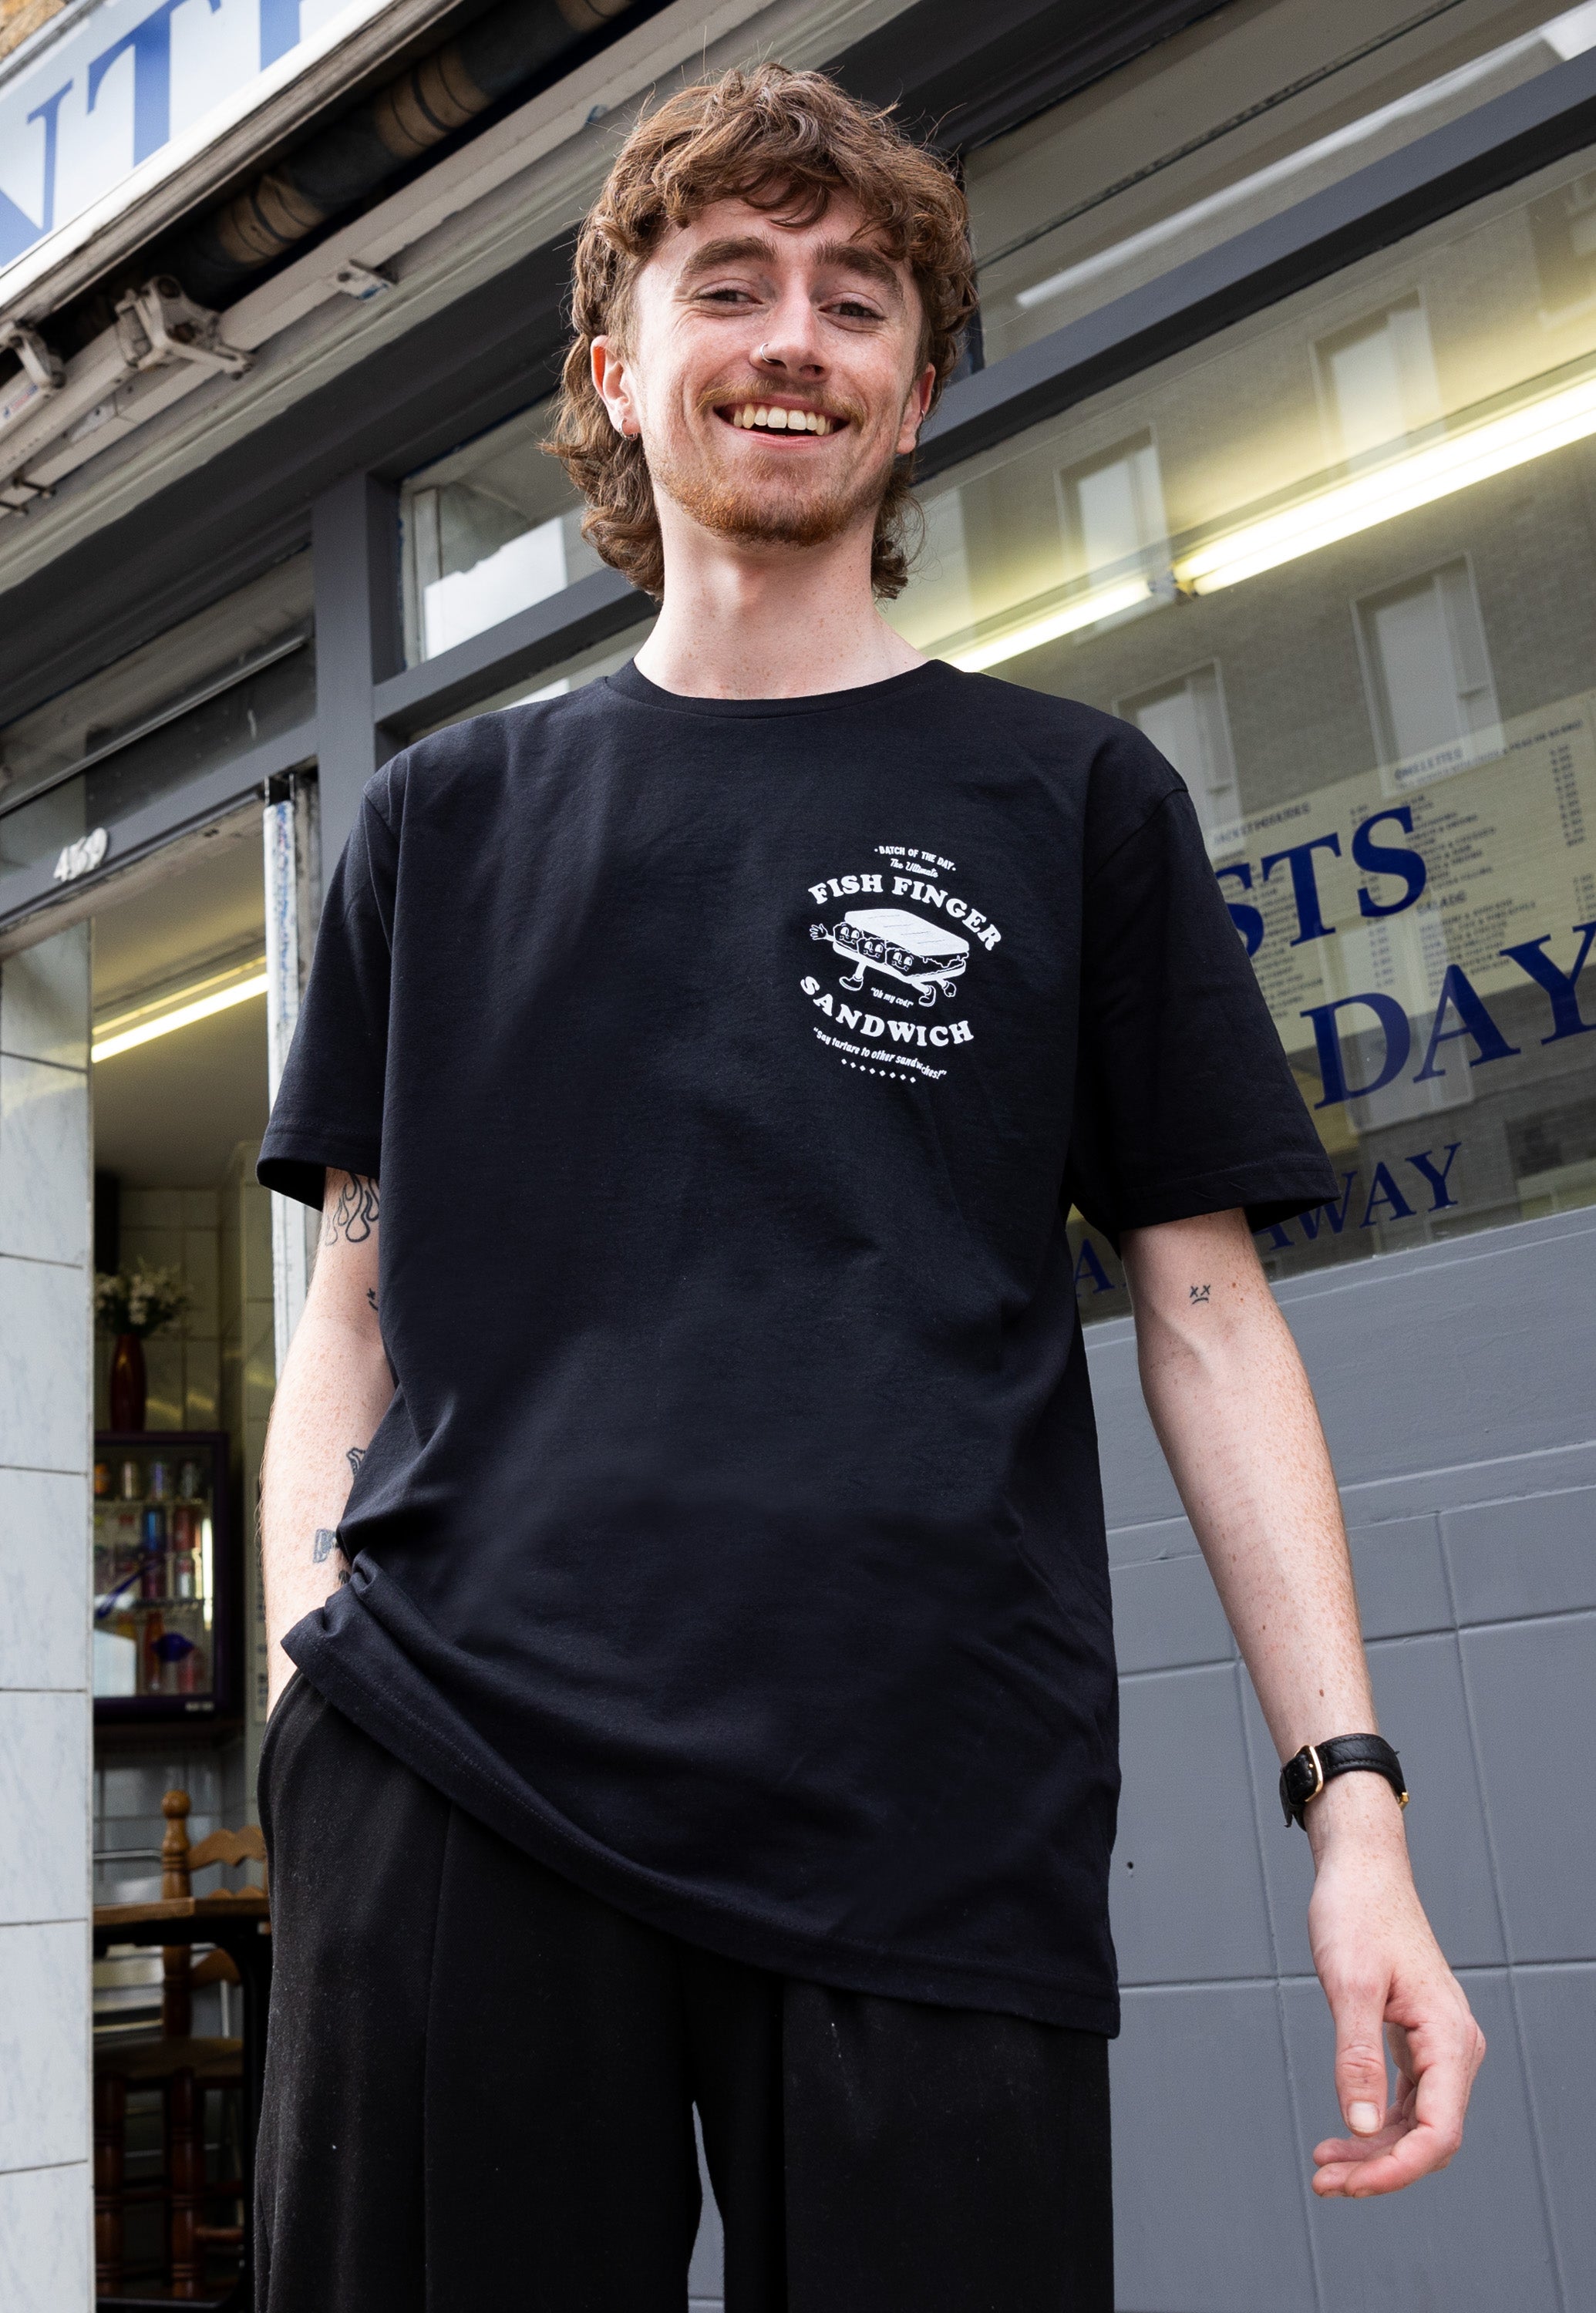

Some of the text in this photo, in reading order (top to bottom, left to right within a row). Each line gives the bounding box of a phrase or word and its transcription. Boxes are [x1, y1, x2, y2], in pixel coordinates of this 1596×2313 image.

[878, 845, 955, 870] BATCH OF THE DAY
[890, 857, 939, 878] The Ultimate
[1212, 806, 1427, 959] STS
[807, 874, 1002, 951] FISH FINGER
[800, 975, 975, 1047] SANDWICH
[883, 993, 896, 1004] my
[1299, 921, 1596, 1110] DAY
[860, 1046, 870, 1058] to
[870, 1049, 896, 1062] other
